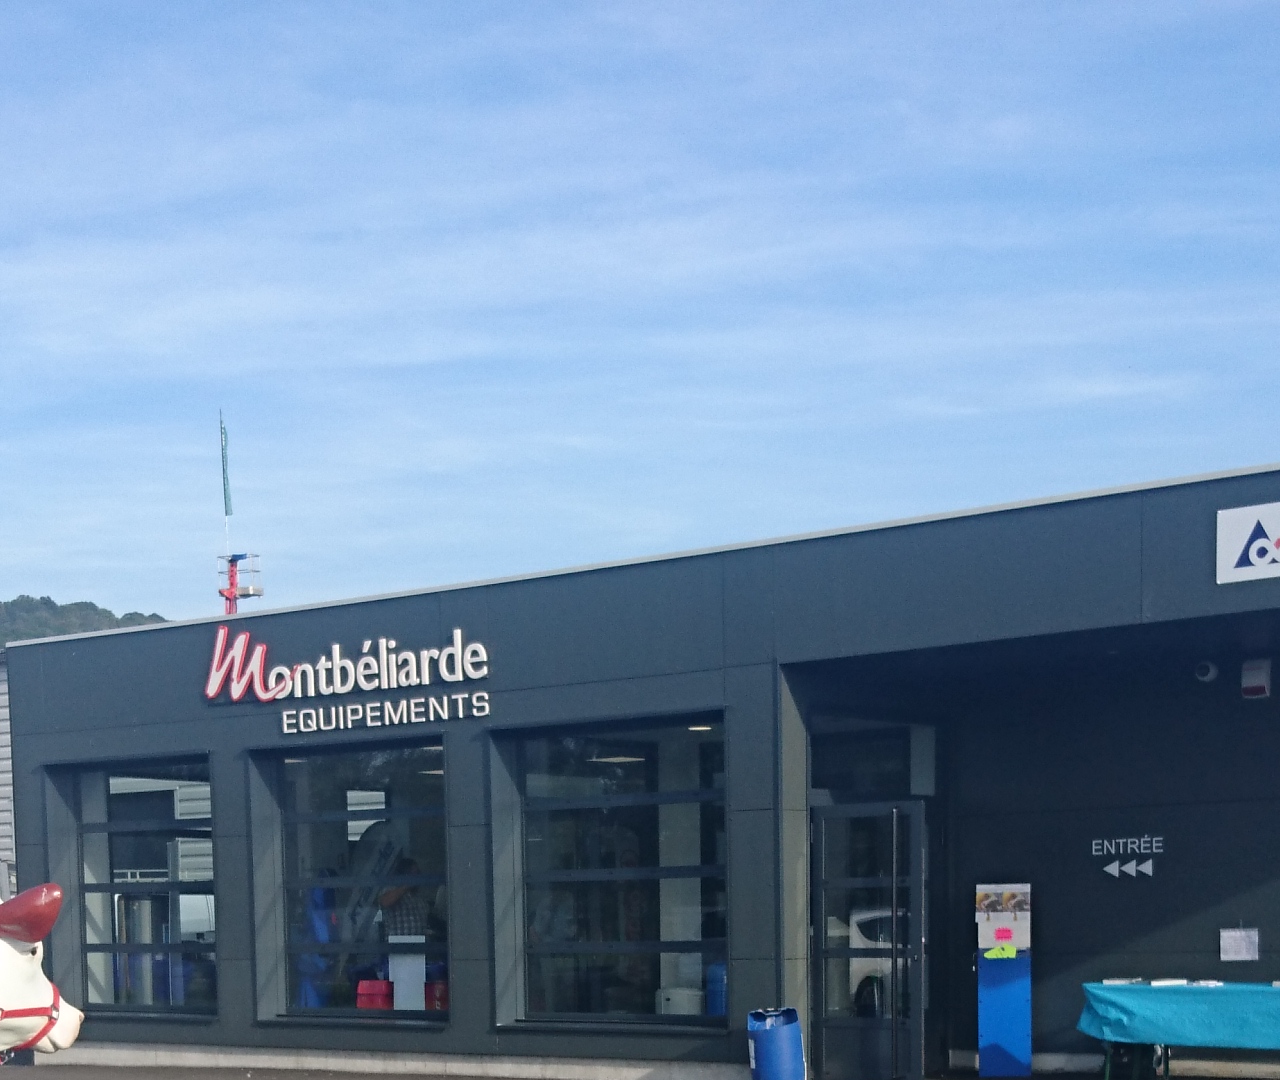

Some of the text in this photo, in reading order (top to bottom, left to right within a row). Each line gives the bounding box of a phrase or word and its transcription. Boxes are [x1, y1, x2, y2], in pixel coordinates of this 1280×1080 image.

[205, 625, 489, 702] Montbéliarde
[282, 692, 490, 734] EQUIPEMENTS
[1091, 834, 1164, 856] ENTRÉE
